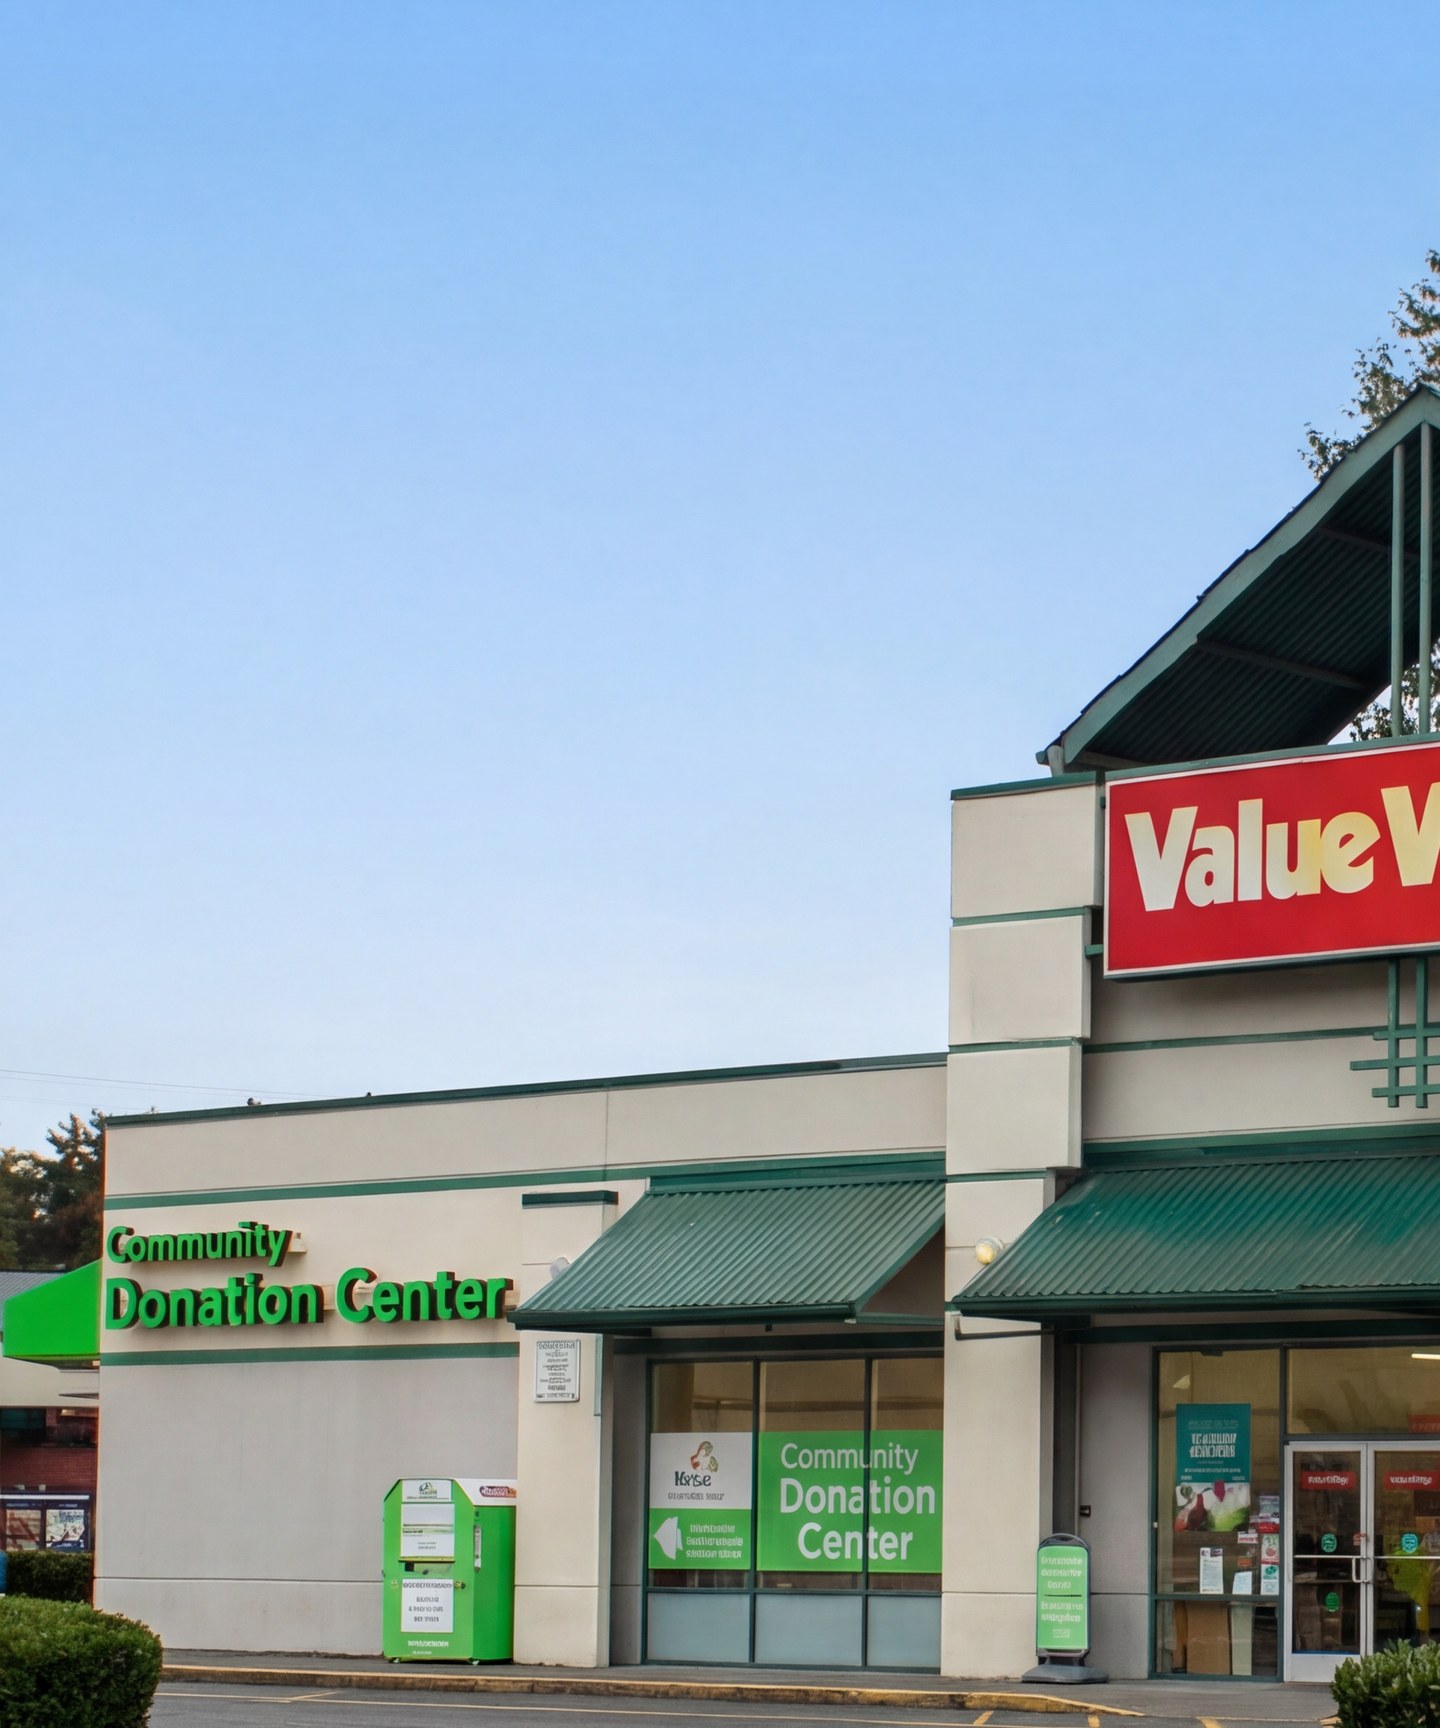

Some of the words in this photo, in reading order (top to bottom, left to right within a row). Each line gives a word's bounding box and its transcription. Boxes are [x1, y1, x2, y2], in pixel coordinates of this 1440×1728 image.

[1125, 798, 1382, 912] Value
[106, 1221, 292, 1267] Community
[105, 1272, 325, 1330] Donation
[336, 1267, 514, 1324] Center
[780, 1442, 919, 1475] Community
[780, 1476, 936, 1515] Donation
[798, 1521, 914, 1560] Center
